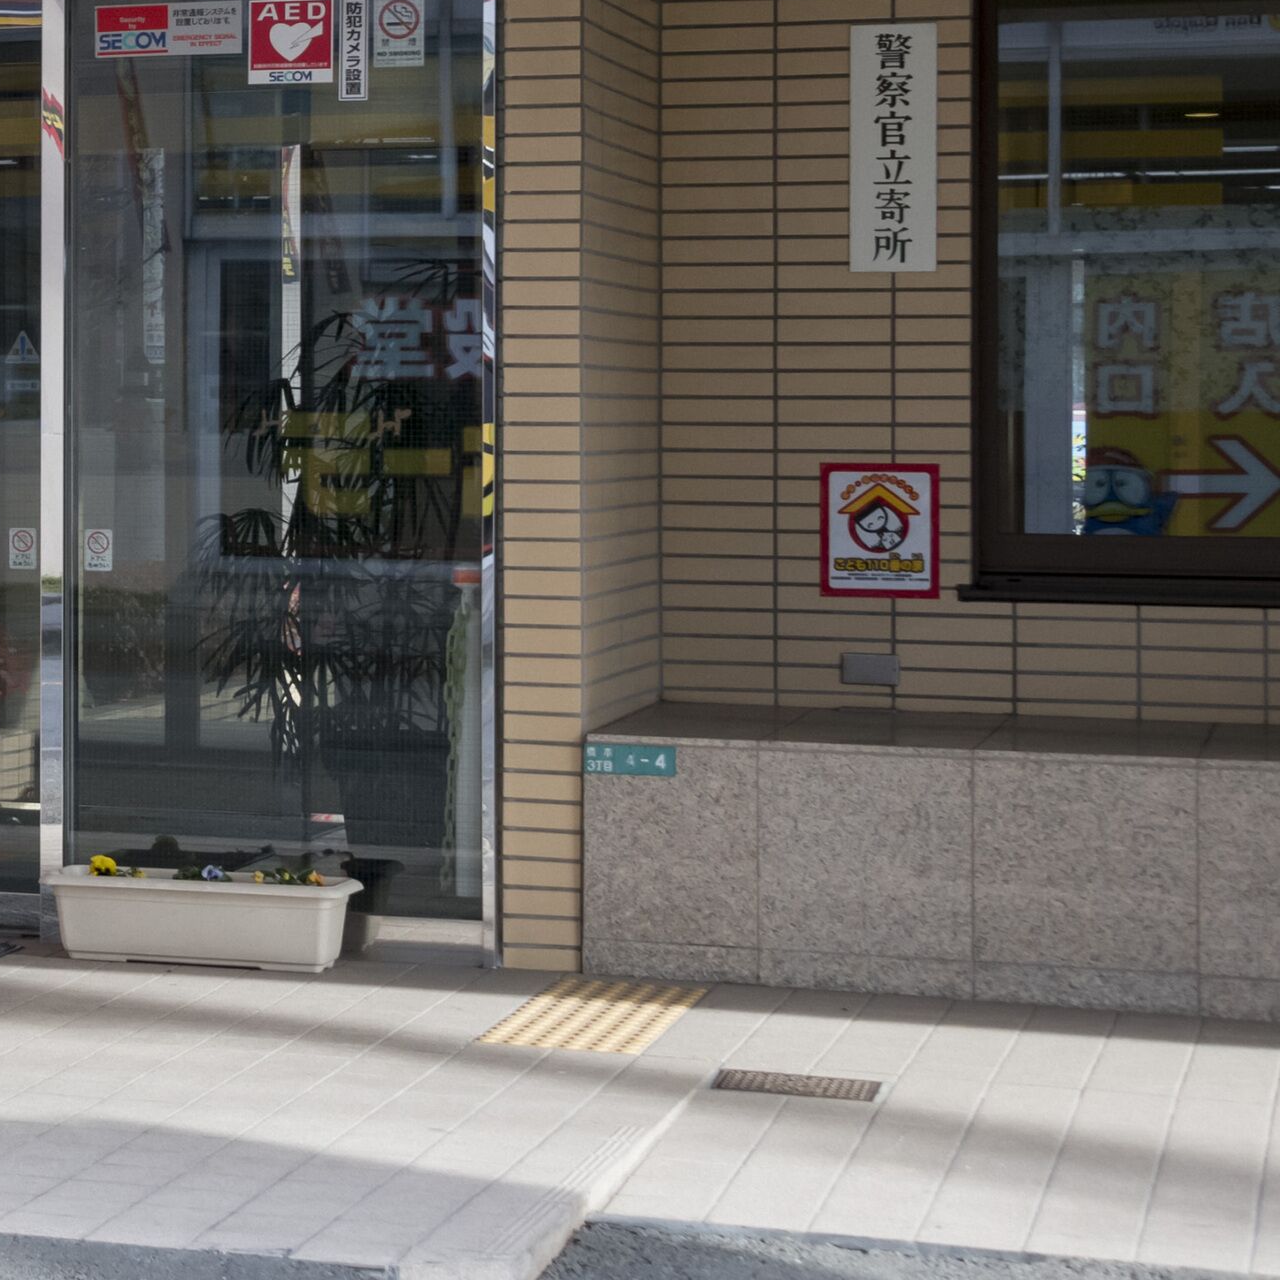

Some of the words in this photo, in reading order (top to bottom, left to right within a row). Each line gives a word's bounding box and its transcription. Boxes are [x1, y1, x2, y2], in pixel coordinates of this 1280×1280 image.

[257, 2, 327, 21] AED
[99, 32, 167, 50] SECOM
[345, 1, 362, 96] 防犯カメラ設置
[269, 70, 312, 82] SECOM
[873, 33, 913, 263] 警察官立寄所
